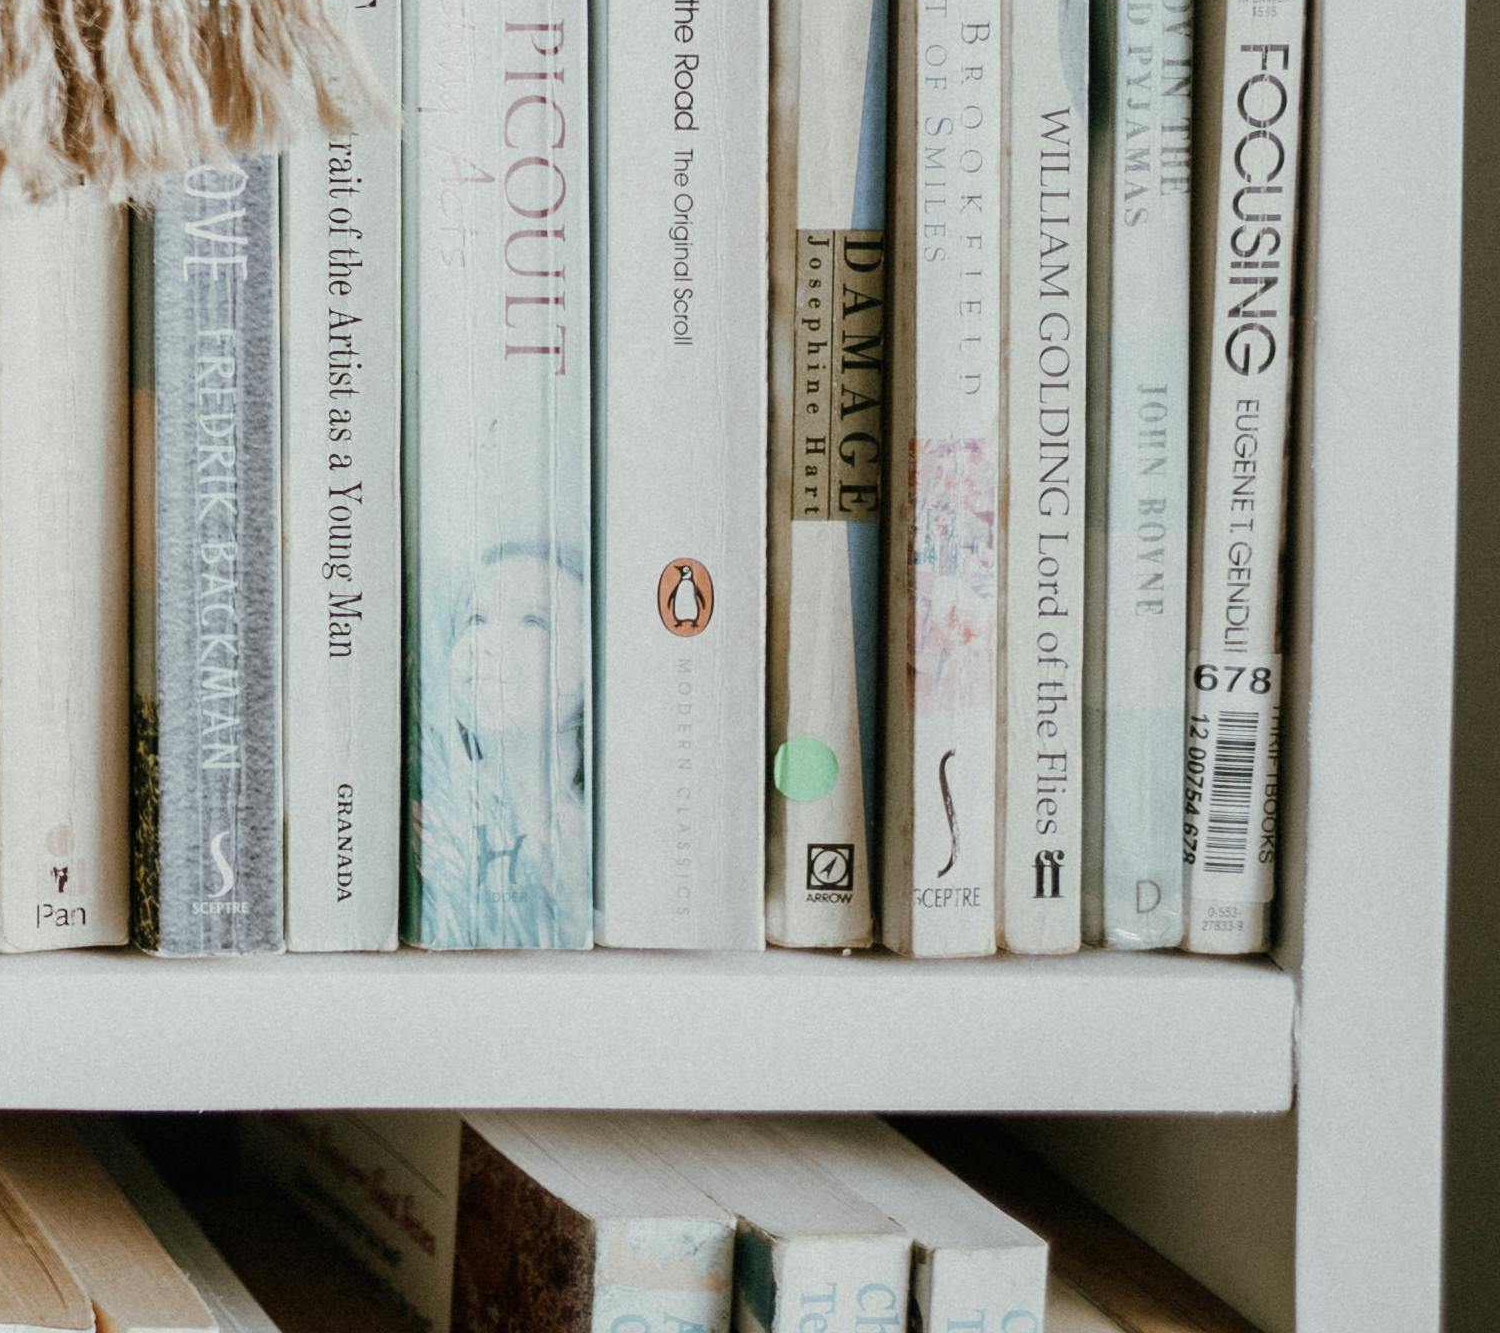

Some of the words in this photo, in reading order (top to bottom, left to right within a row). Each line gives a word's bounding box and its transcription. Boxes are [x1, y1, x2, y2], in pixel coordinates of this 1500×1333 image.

[672, 53, 700, 132] Road
[673, 149, 694, 187] The
[1037, 106, 1072, 300] WILLIAM
[1224, 43, 1290, 376] FOCUSING
[668, 193, 693, 282] Original
[672, 286, 693, 346] Scroll
[803, 234, 830, 416] Josephine
[838, 235, 885, 515] DAMAGE
[1038, 308, 1073, 519] GOLDING
[803, 435, 827, 515] Hart
[1037, 531, 1071, 619] Lord
[1037, 627, 1070, 669] of
[1192, 663, 1272, 695] 678
[1037, 671, 1071, 741] the
[1034, 750, 1070, 836] Flies
[336, 783, 354, 903] GRANADA
